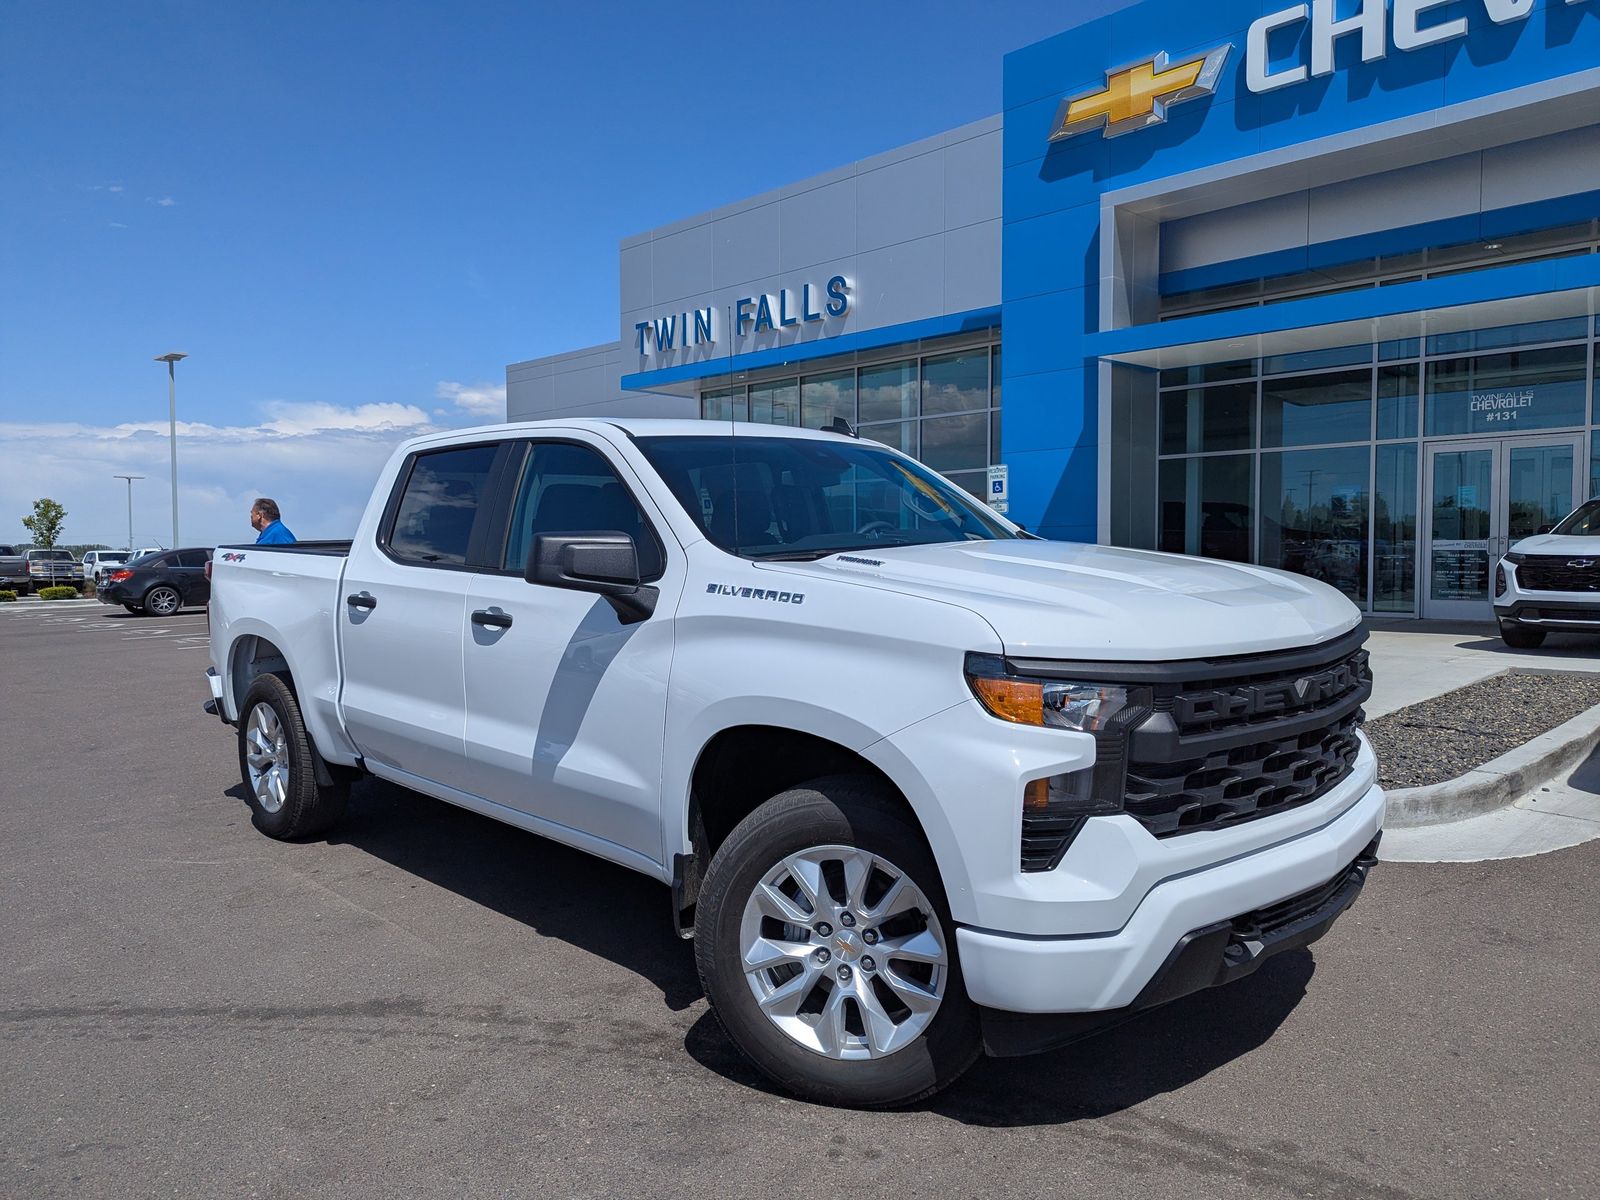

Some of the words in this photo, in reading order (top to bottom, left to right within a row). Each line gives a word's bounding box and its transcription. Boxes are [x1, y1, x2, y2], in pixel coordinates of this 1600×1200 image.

[635, 307, 716, 355] TWIN
[736, 275, 854, 336] FALLS
[1470, 396, 1534, 411] CHEVROLET
[1486, 410, 1518, 422] #131
[706, 583, 805, 604] SILVERADO
[1174, 648, 1371, 724] CHEVROLE
